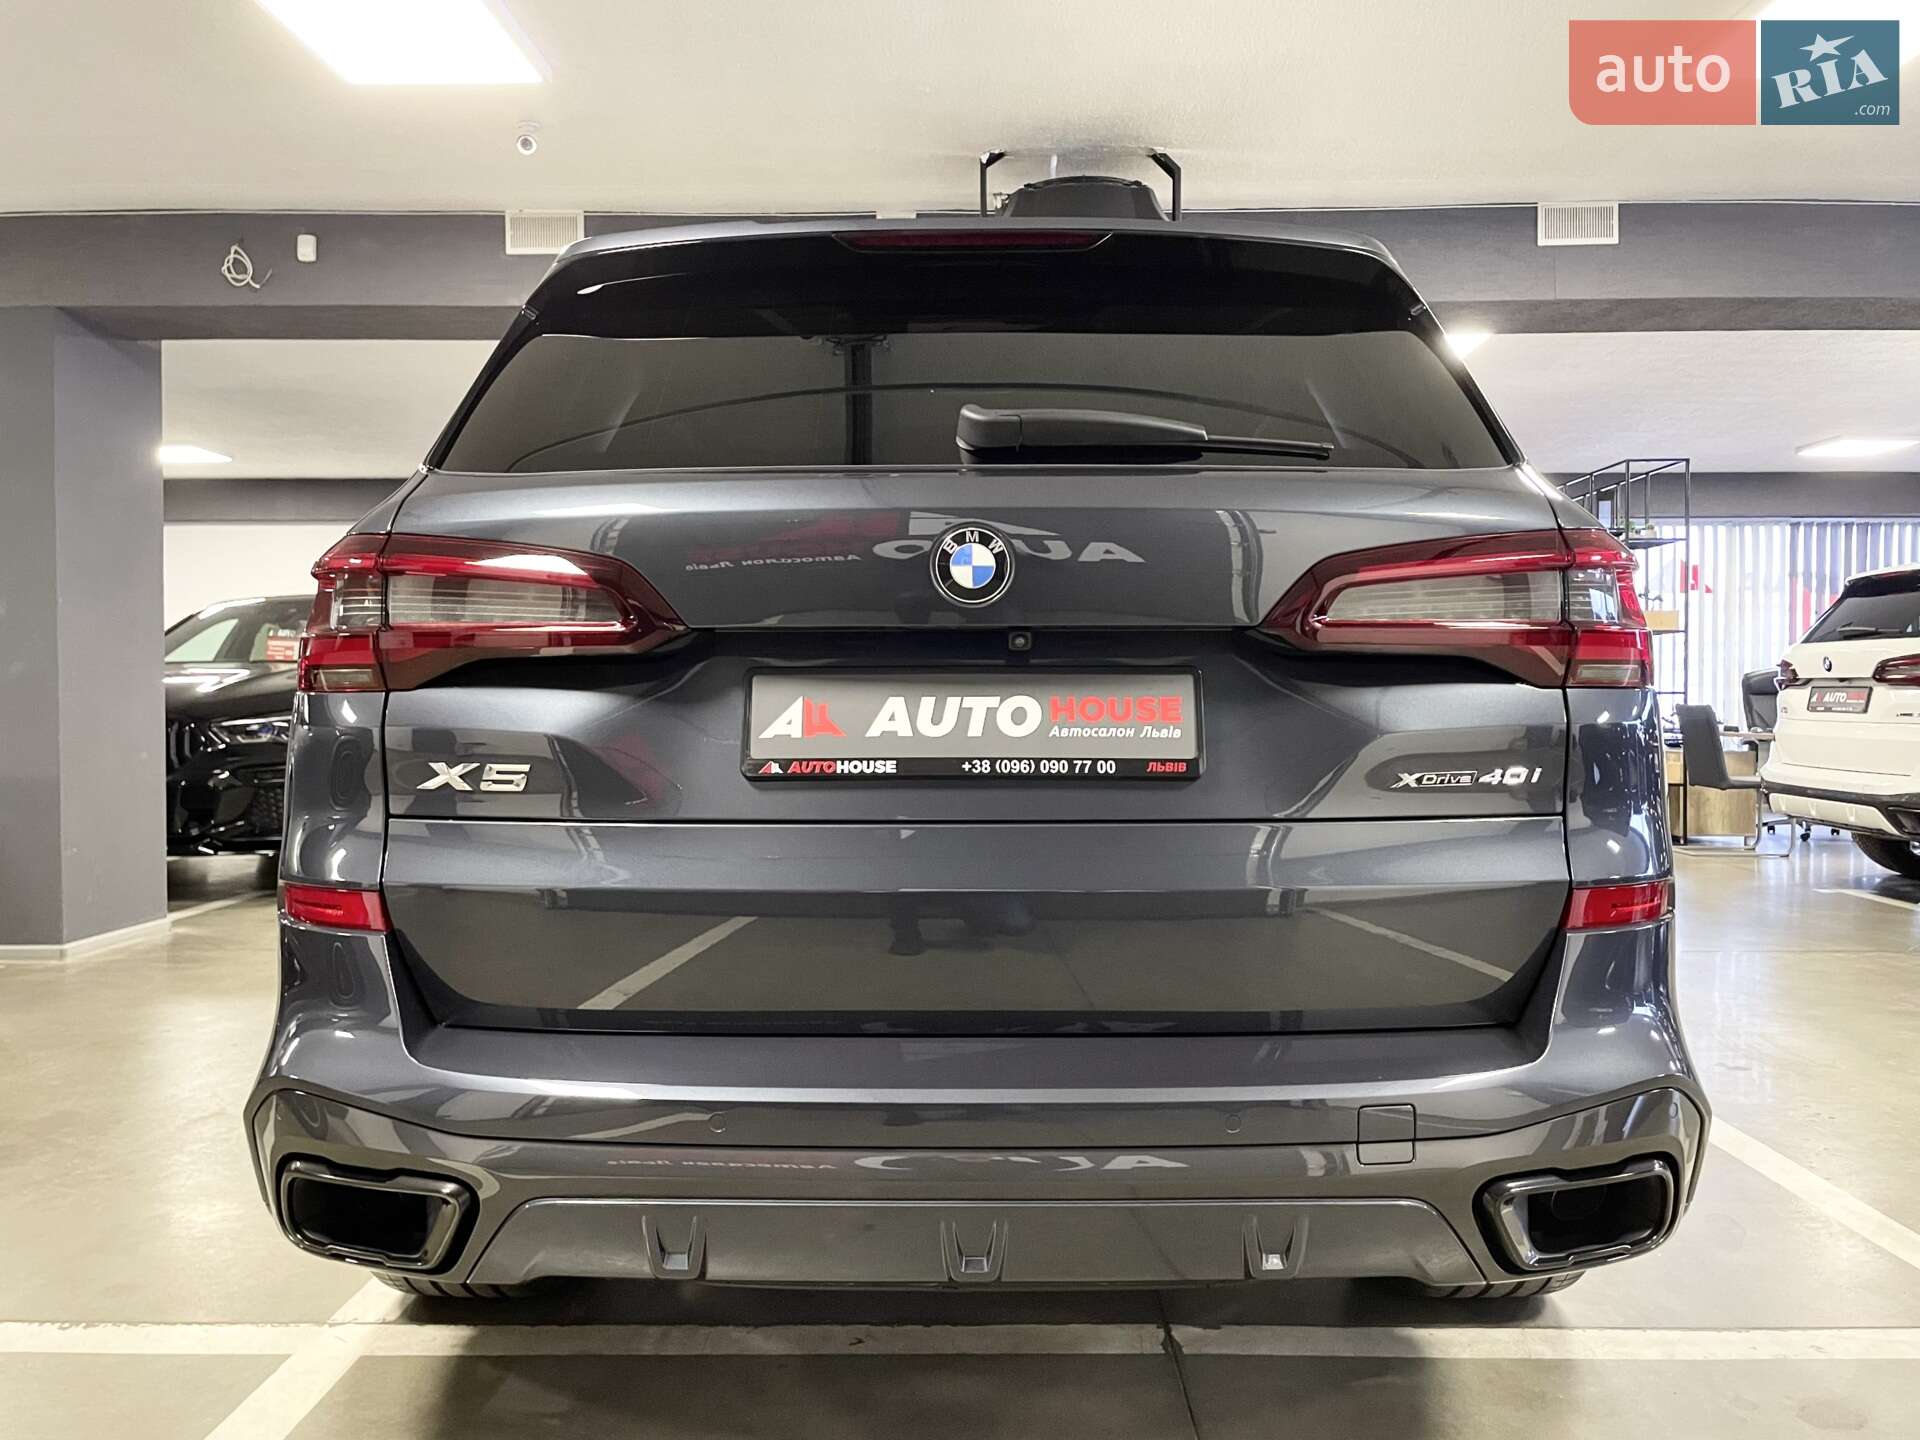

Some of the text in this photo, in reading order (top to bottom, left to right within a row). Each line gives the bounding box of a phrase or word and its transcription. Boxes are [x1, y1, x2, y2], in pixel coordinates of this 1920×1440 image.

[943, 530, 1004, 555] BMW
[865, 695, 1042, 738] AUTO
[1049, 696, 1184, 723] HOUSE
[1048, 725, 1182, 738] Автосалон Львів
[416, 762, 531, 792] X5
[787, 760, 897, 774] AUTOHOUSE
[961, 759, 1116, 775] +38 (096) 090 77 00
